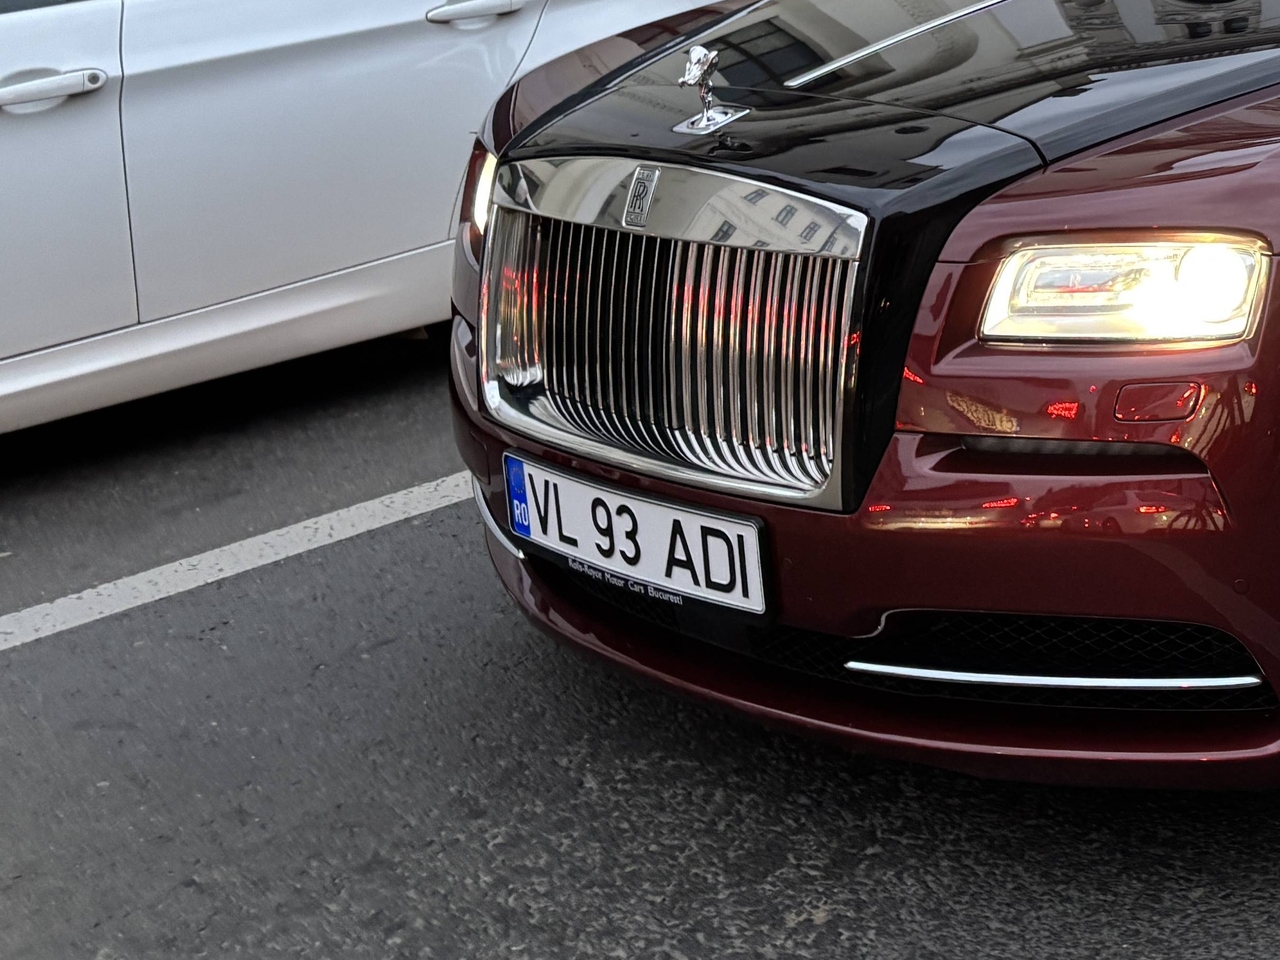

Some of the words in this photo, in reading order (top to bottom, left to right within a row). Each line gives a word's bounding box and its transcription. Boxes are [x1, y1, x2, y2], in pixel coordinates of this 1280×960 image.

[514, 500, 529, 526] RO
[528, 473, 578, 548] VL
[591, 497, 641, 566] 93
[665, 519, 750, 599] ADI
[604, 572, 625, 588] Motor
[628, 581, 645, 594] Cars
